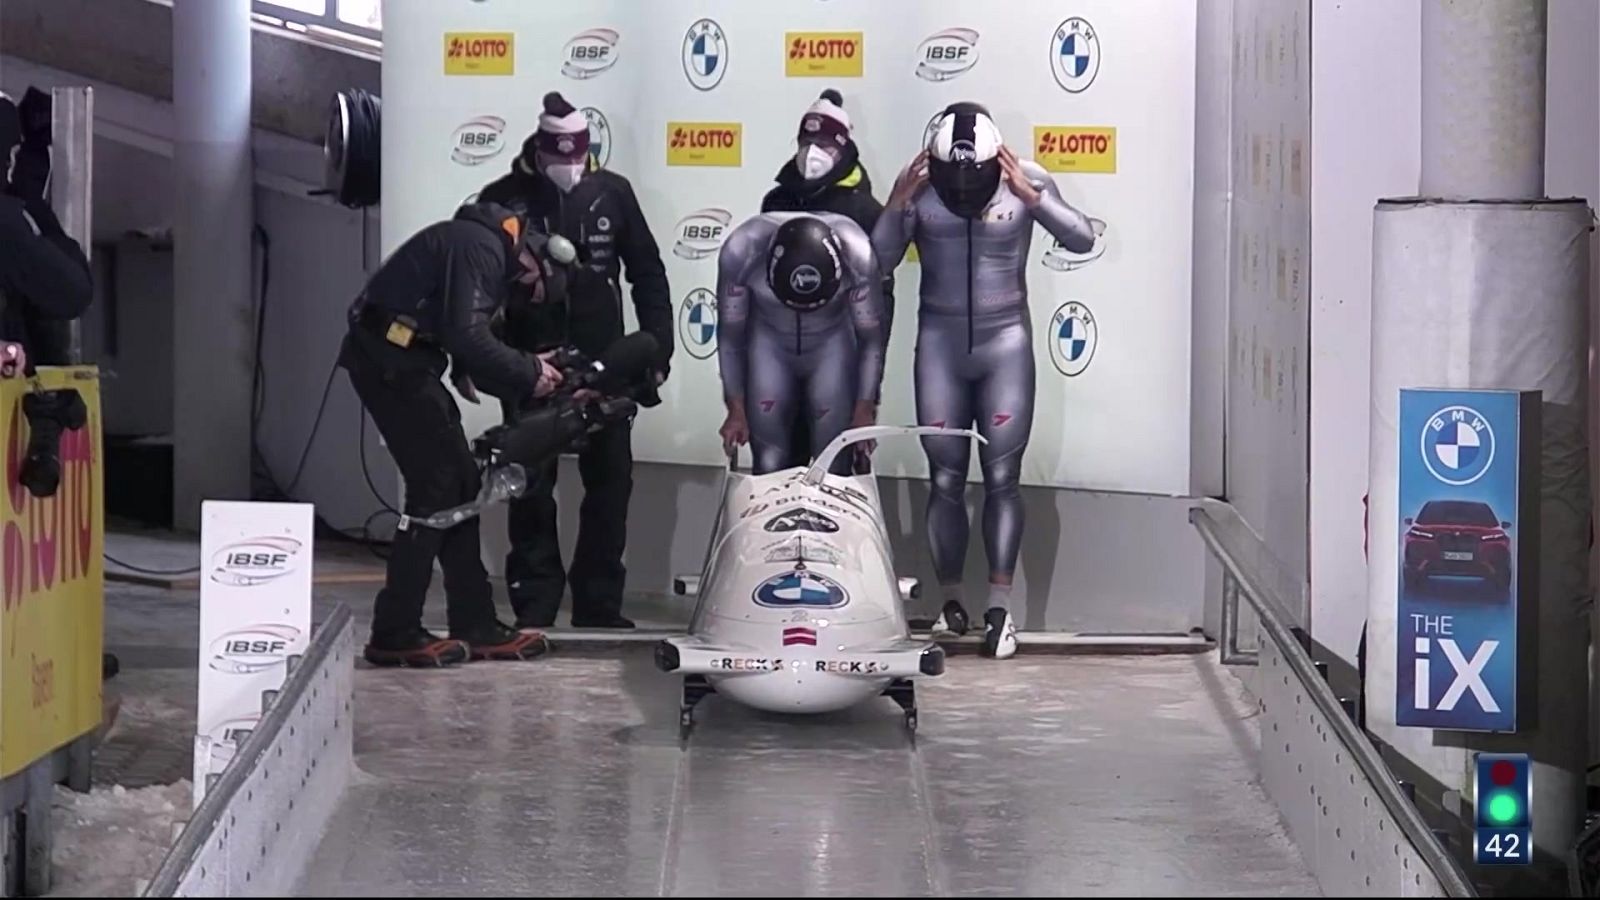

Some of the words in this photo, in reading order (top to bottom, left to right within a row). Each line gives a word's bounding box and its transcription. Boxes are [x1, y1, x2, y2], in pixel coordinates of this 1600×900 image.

[1057, 21, 1093, 41] BMW
[465, 39, 507, 57] LOTTO
[571, 46, 610, 58] IBSF
[809, 40, 855, 58] LOTTO
[926, 46, 969, 59] IBSF
[460, 132, 497, 145] IBSF
[690, 130, 734, 148] LOTTO
[1059, 134, 1108, 154] LOTTO
[683, 225, 722, 239] IBSF
[1055, 305, 1092, 325] BMW
[1431, 410, 1486, 432] BMW
[226, 553, 288, 566] IBSF
[1410, 613, 1454, 635] THE
[225, 640, 287, 653] IBSF
[1414, 637, 1502, 713] iX
